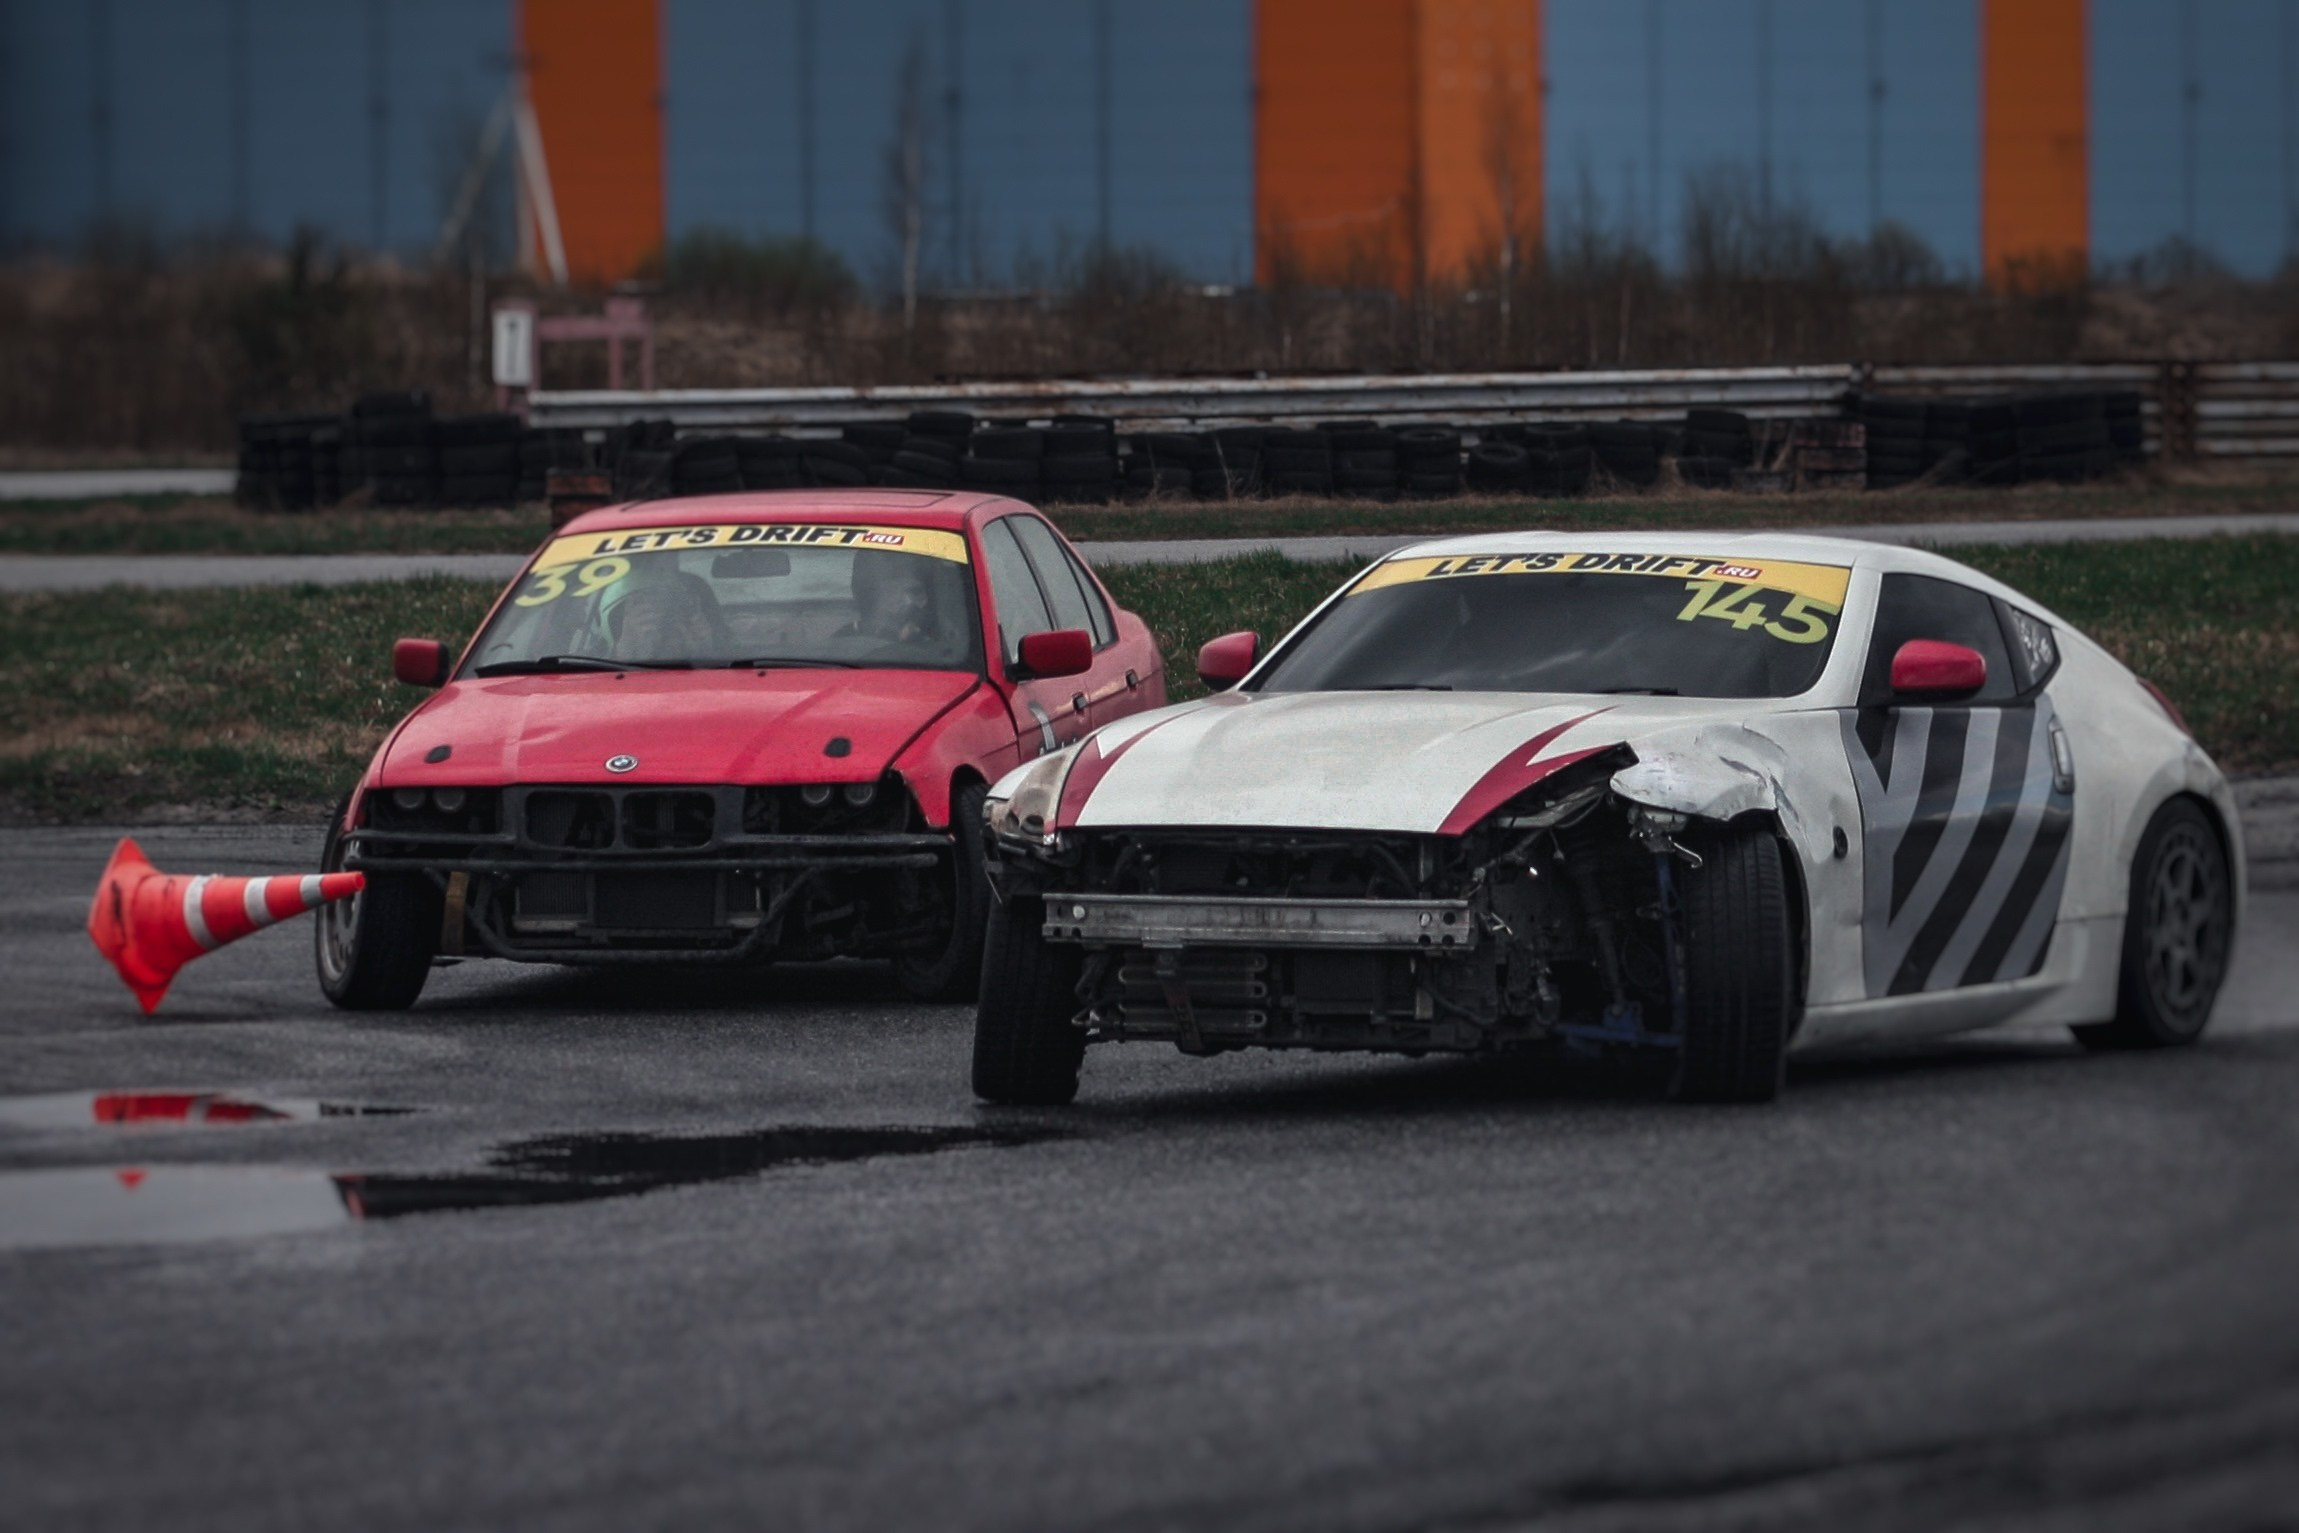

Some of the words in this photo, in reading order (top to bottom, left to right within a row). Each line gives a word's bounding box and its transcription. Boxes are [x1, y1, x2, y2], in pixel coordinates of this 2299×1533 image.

[593, 528, 719, 555] LET'S
[515, 557, 631, 607] 39
[1424, 553, 1565, 577] LET'S
[1676, 580, 1842, 644] 145
